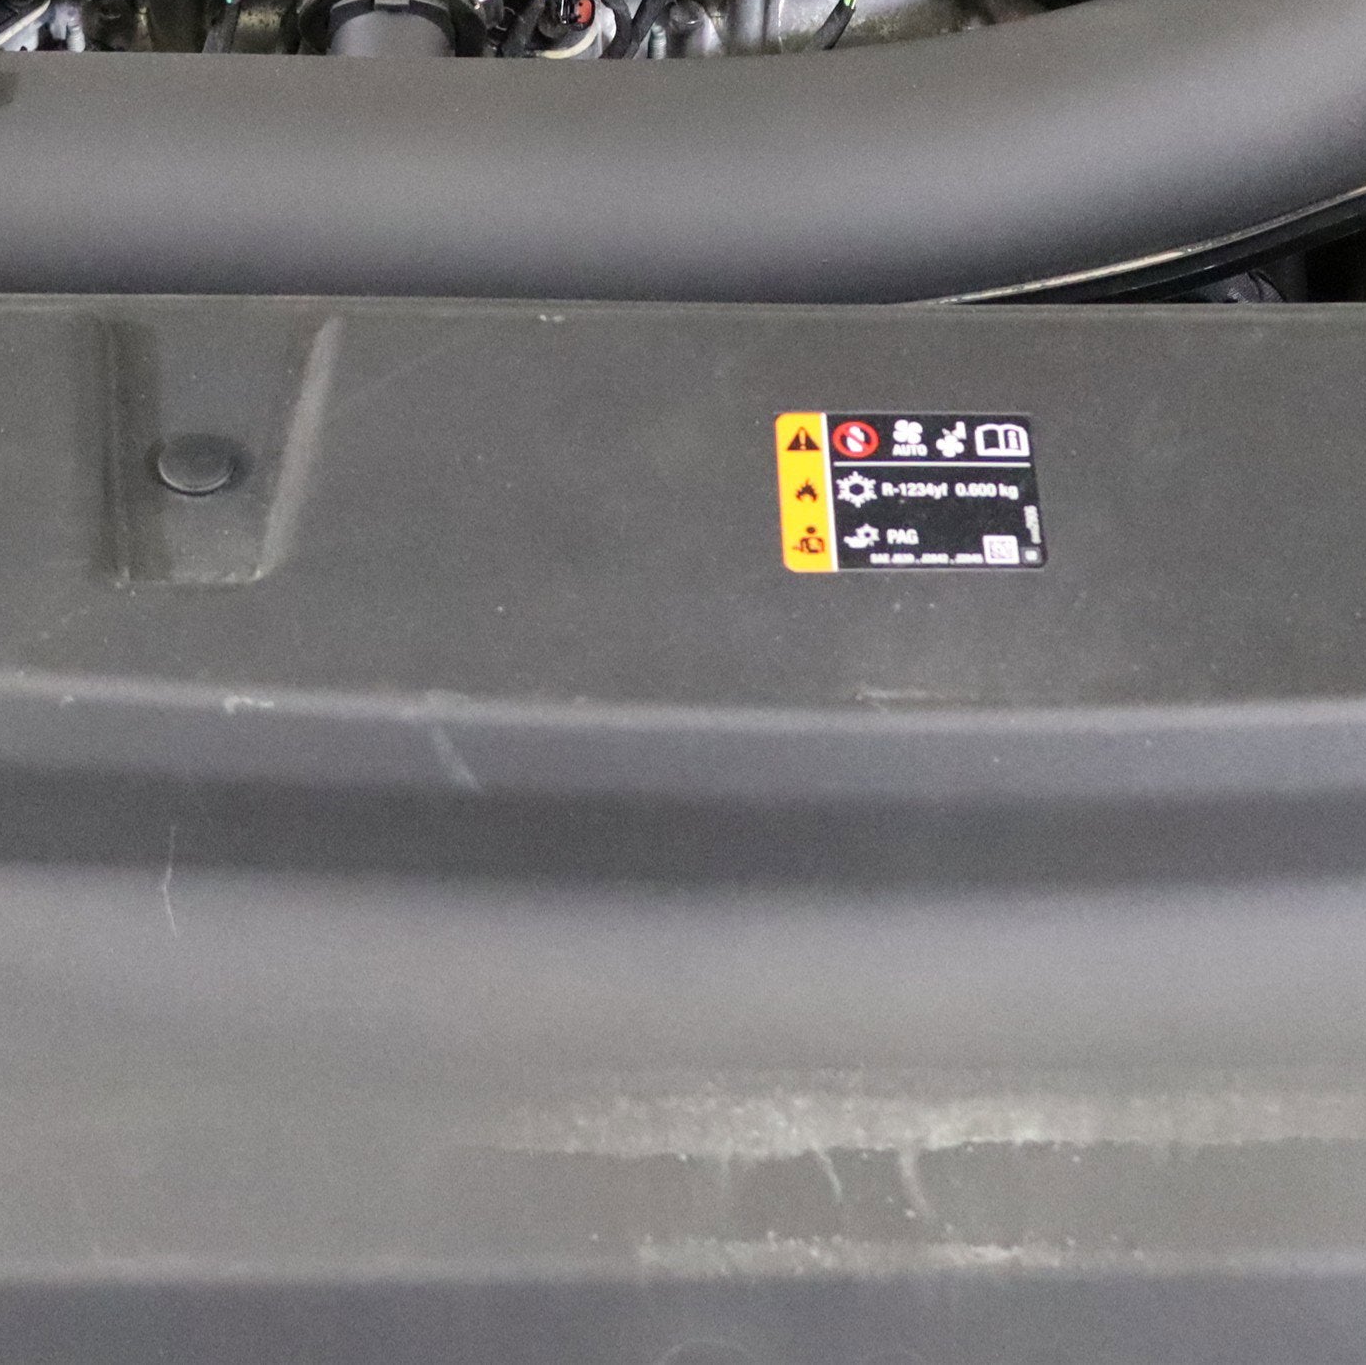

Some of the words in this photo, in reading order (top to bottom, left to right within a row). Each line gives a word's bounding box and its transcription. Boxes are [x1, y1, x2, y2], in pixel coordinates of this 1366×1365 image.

[891, 443, 928, 457] AUTO
[881, 482, 948, 500] R-1234yf
[998, 483, 1019, 500] kg
[886, 528, 920, 545] PAG
